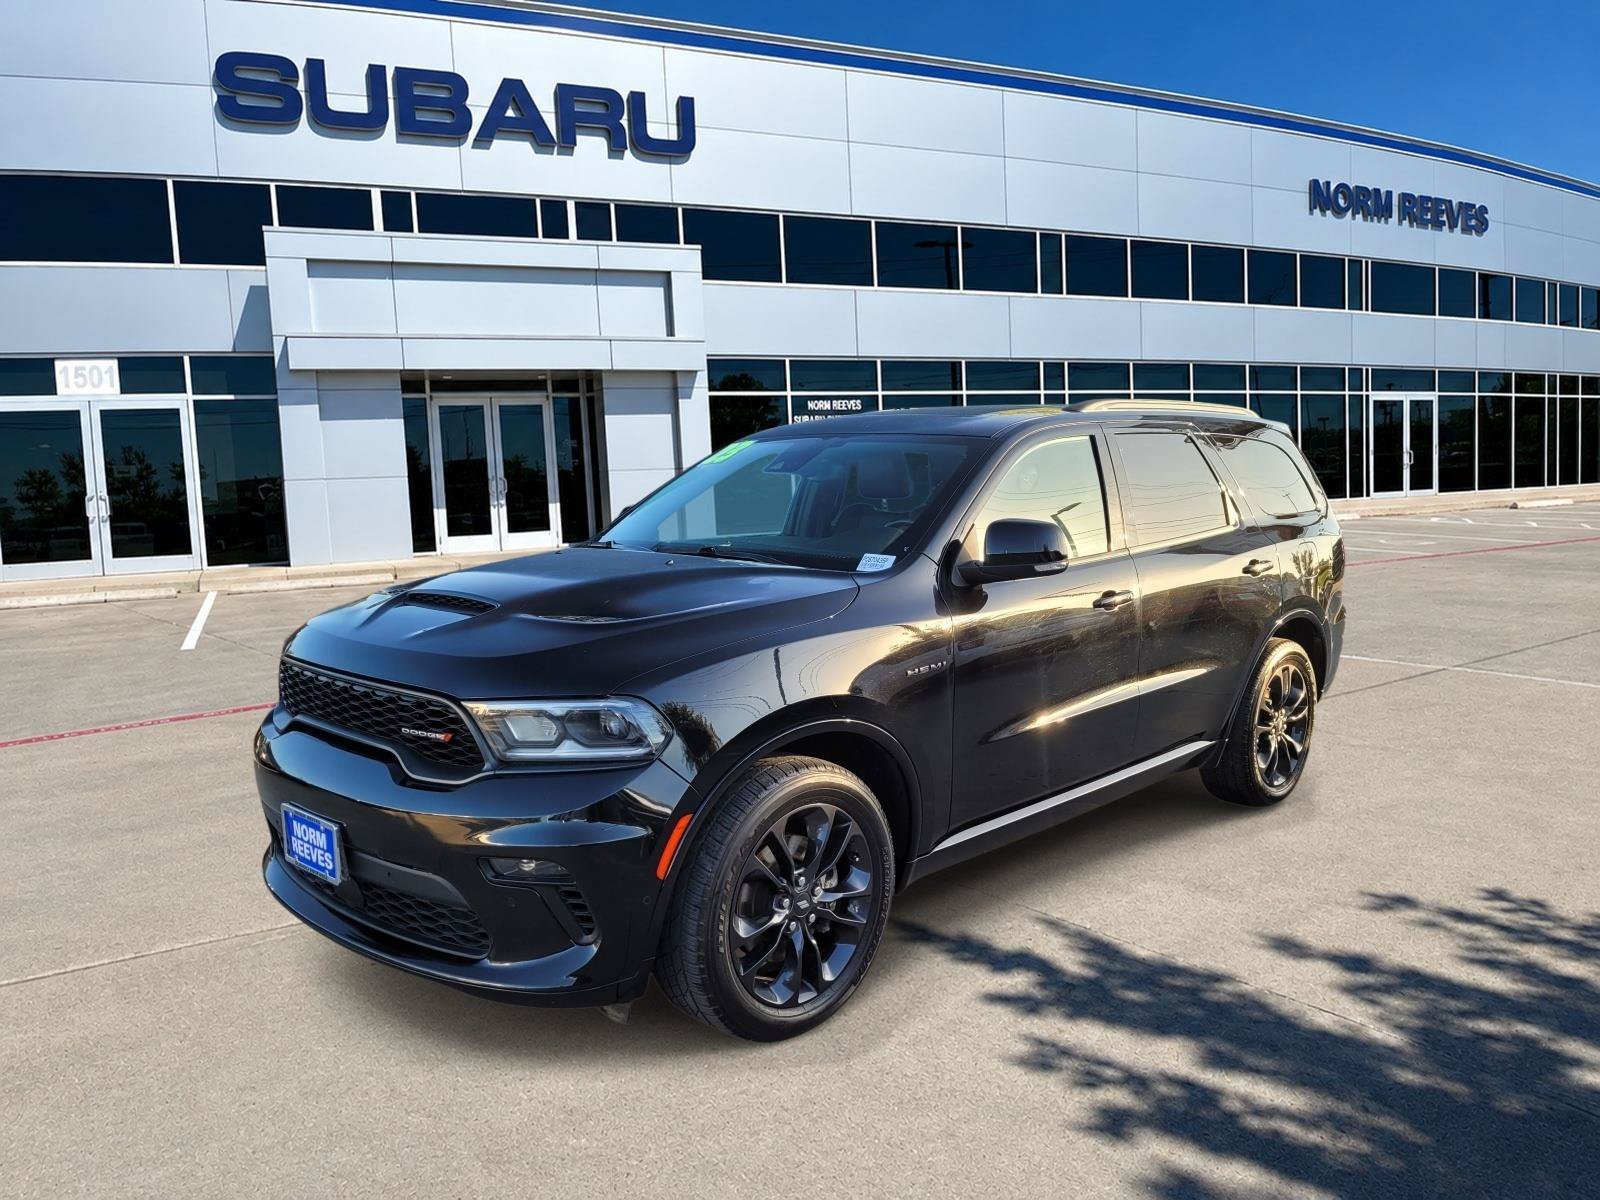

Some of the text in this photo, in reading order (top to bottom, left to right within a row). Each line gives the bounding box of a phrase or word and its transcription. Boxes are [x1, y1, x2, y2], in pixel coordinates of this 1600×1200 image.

[214, 51, 695, 158] SUBARU
[1309, 178, 1489, 237] NORM REEVES
[59, 365, 115, 388] 1501
[807, 399, 862, 411] NORM REEVES
[905, 660, 947, 677] HEMI
[401, 727, 445, 741] DODGE
[292, 819, 328, 850] NORM
[290, 835, 334, 871] REEVES
